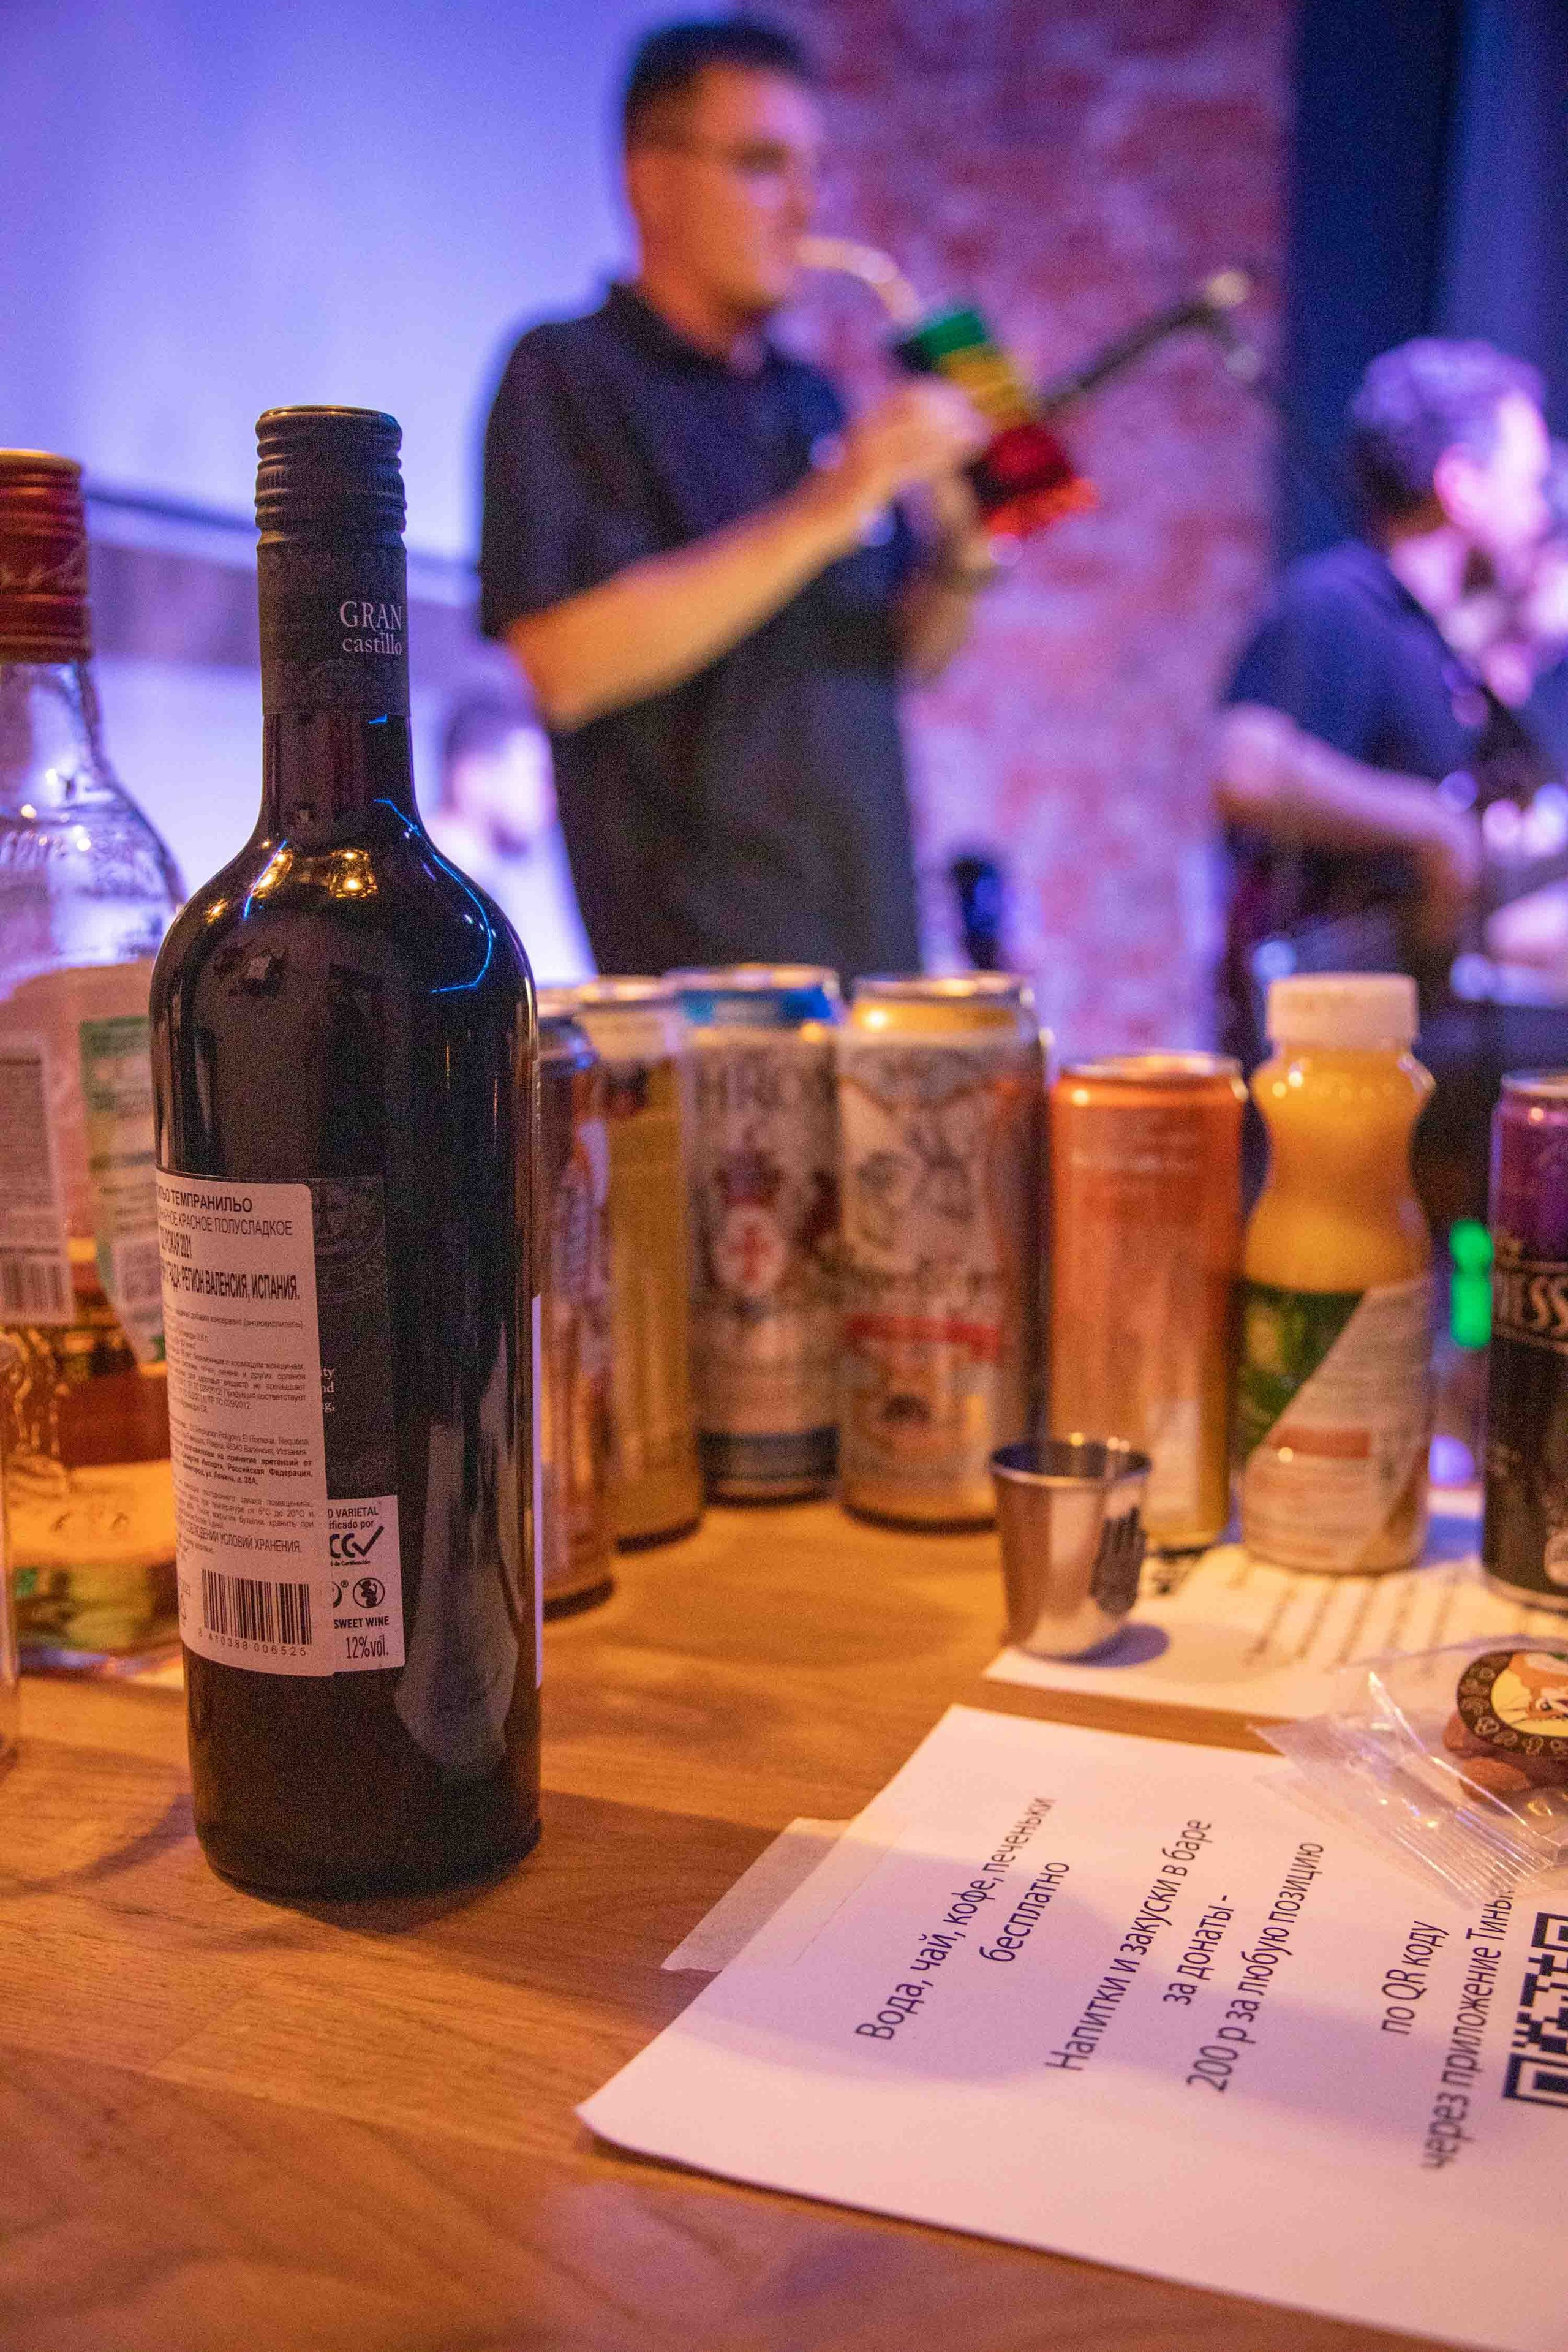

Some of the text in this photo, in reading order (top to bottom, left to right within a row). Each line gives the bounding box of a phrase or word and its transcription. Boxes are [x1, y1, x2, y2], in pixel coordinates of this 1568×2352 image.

[339, 600, 402, 631] GRAN
[343, 629, 402, 655] castillo
[171, 1188, 253, 1213] ТЕМПРАНИЛЬО
[178, 1212, 213, 1232] КРАСНОЕ
[214, 1217, 293, 1238] ПОЛУСЛАДКОЕ
[206, 1270, 250, 1303] ВАЛЕНСИЯ,
[251, 1273, 300, 1300] ИСПАНИЯ.
[261, 1458, 299, 1468] претензий
[269, 1467, 314, 1479] Федерация,
[335, 1506, 380, 1518] VARIETAL
[360, 1520, 374, 1530] por
[334, 1615, 390, 1629] SWEET WINE
[854, 1795, 1058, 2041] Вода, чай, кофе, печеньки
[979, 1861, 1071, 1963] бесплатно
[1044, 1819, 1212, 2071] Напитки и закуски в баре
[1176, 1904, 1235, 1981] донаты
[1185, 1842, 1325, 2094] 200 р за любую позицию
[1380, 1920, 1451, 2036] по QR коду
[1164, 1982, 1199, 2007] за
[1440, 1950, 1503, 2089] приложение
[1421, 2090, 1476, 2171] через
